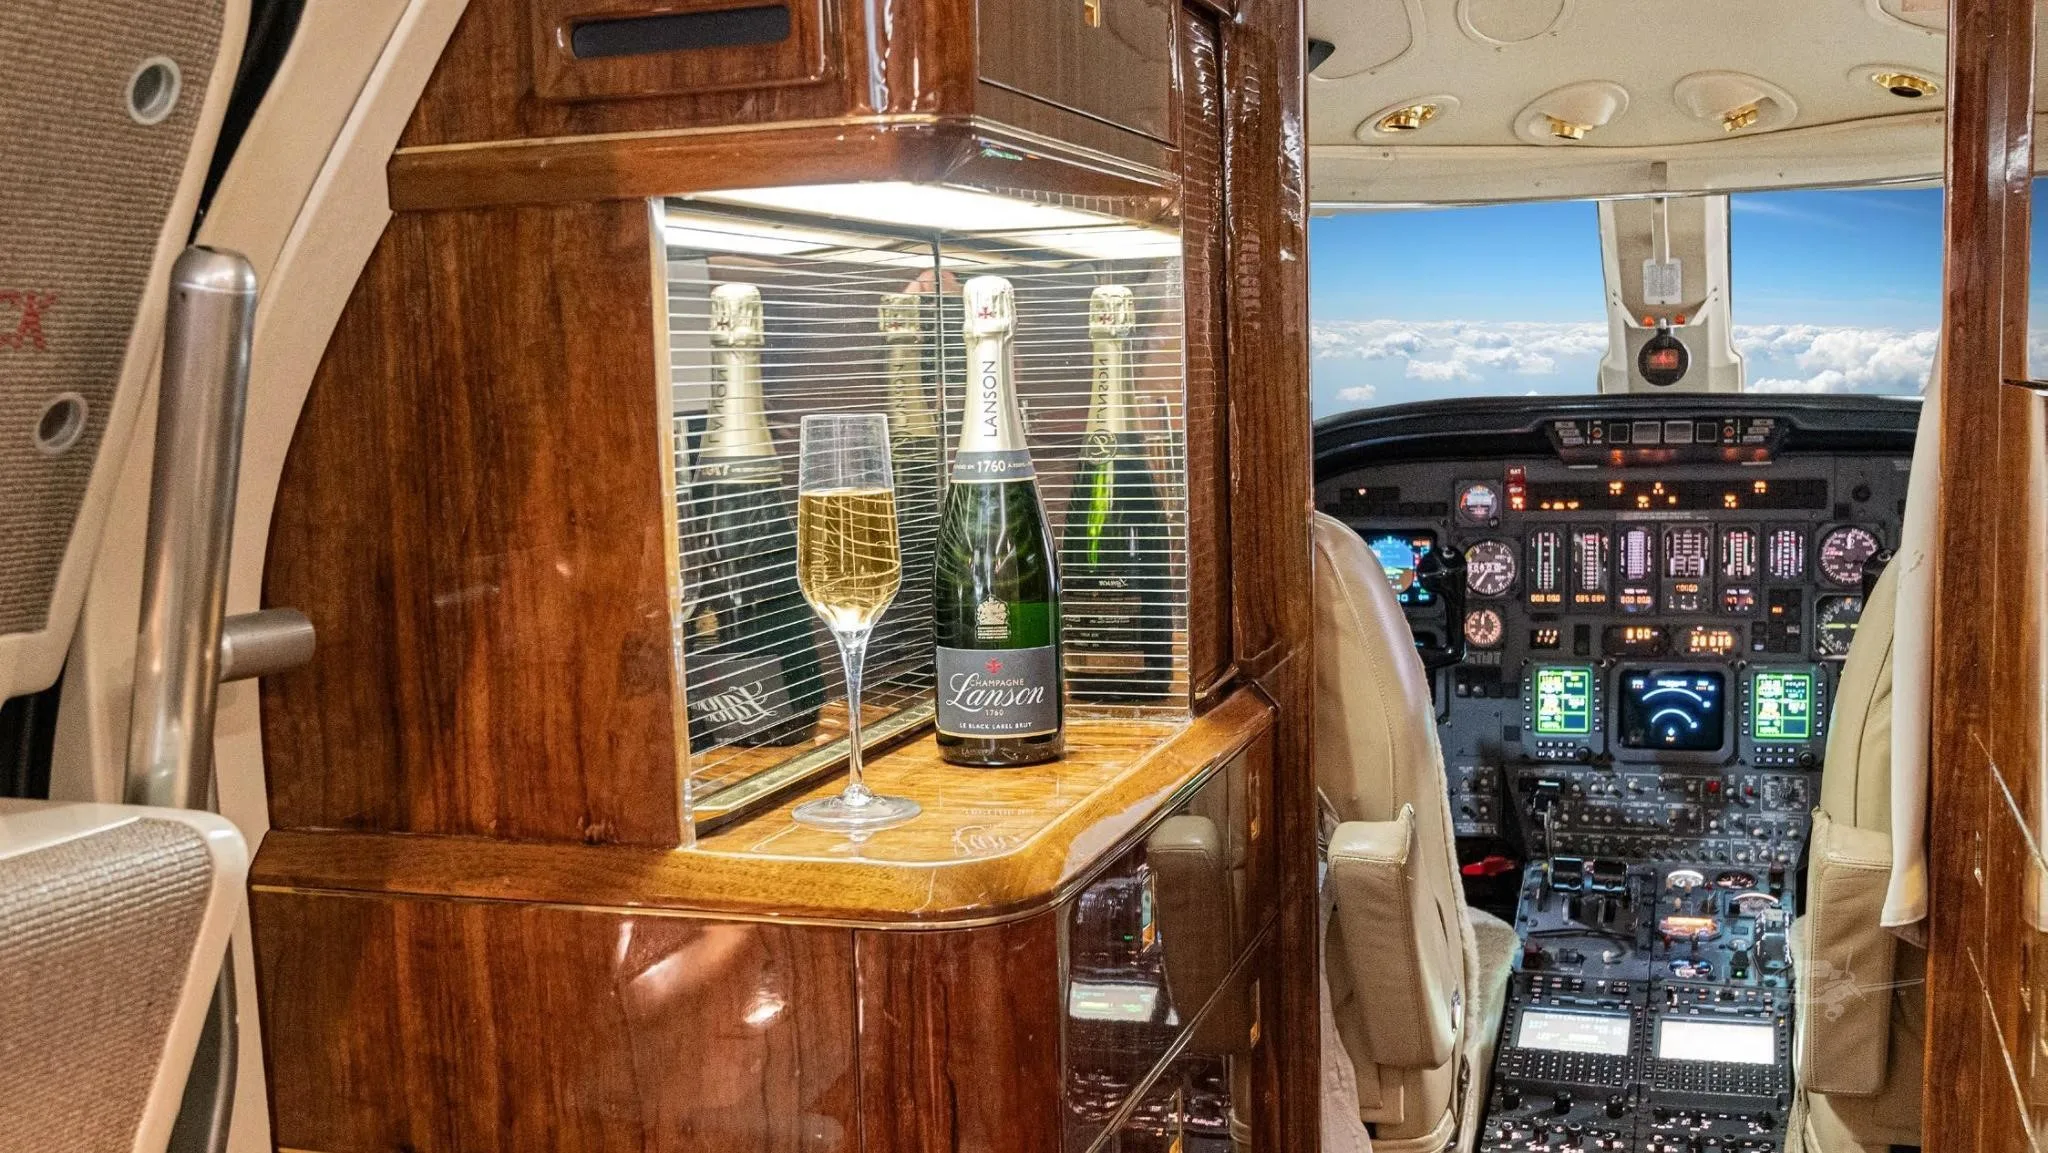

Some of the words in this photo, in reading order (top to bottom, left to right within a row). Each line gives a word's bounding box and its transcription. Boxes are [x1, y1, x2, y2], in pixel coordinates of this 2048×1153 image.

[983, 361, 997, 437] LANSON
[977, 460, 1006, 473] 1760
[969, 679, 1024, 687] CHAMPAGNE
[946, 673, 1044, 712] Lanson
[968, 722, 990, 730] BLACK
[1014, 721, 1033, 729] BRUT
